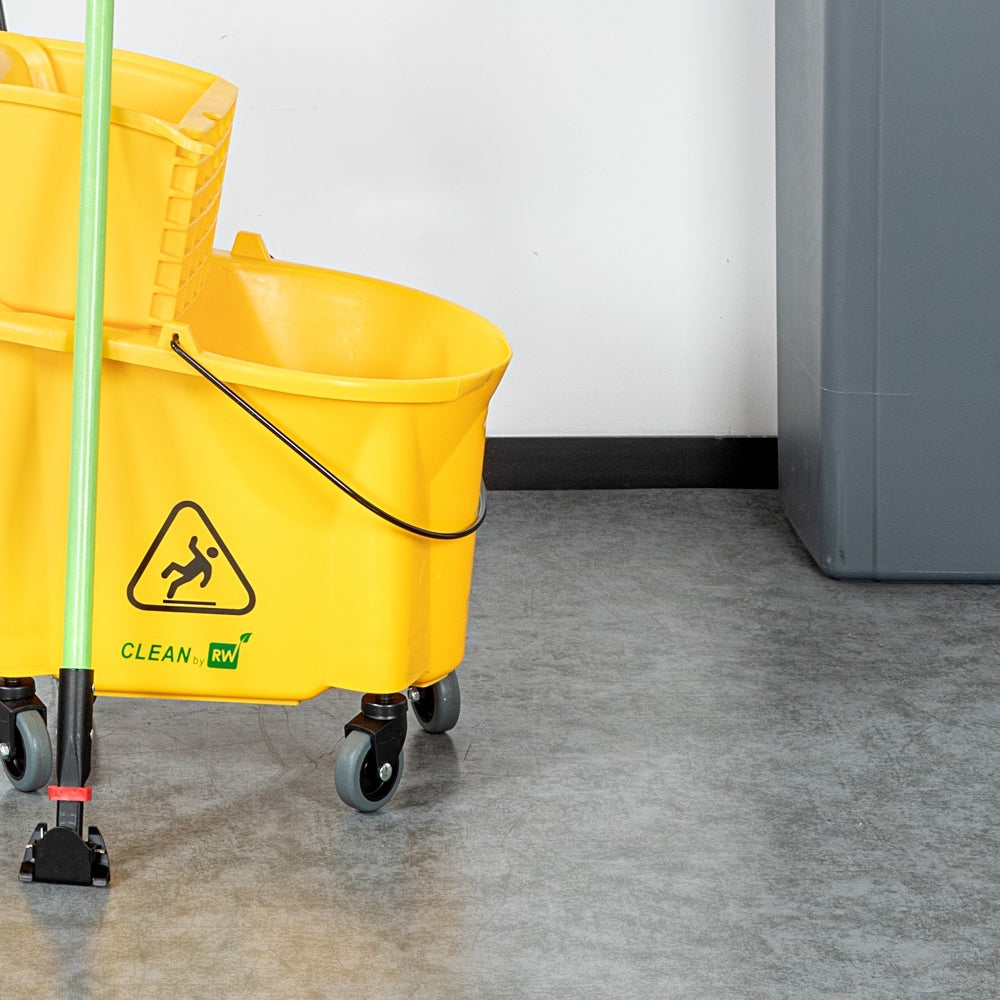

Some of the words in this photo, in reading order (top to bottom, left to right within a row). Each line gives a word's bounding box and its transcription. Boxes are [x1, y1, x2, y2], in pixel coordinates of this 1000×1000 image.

[121, 642, 191, 663] CLEAN
[192, 656, 205, 667] by
[211, 648, 237, 663] RW
